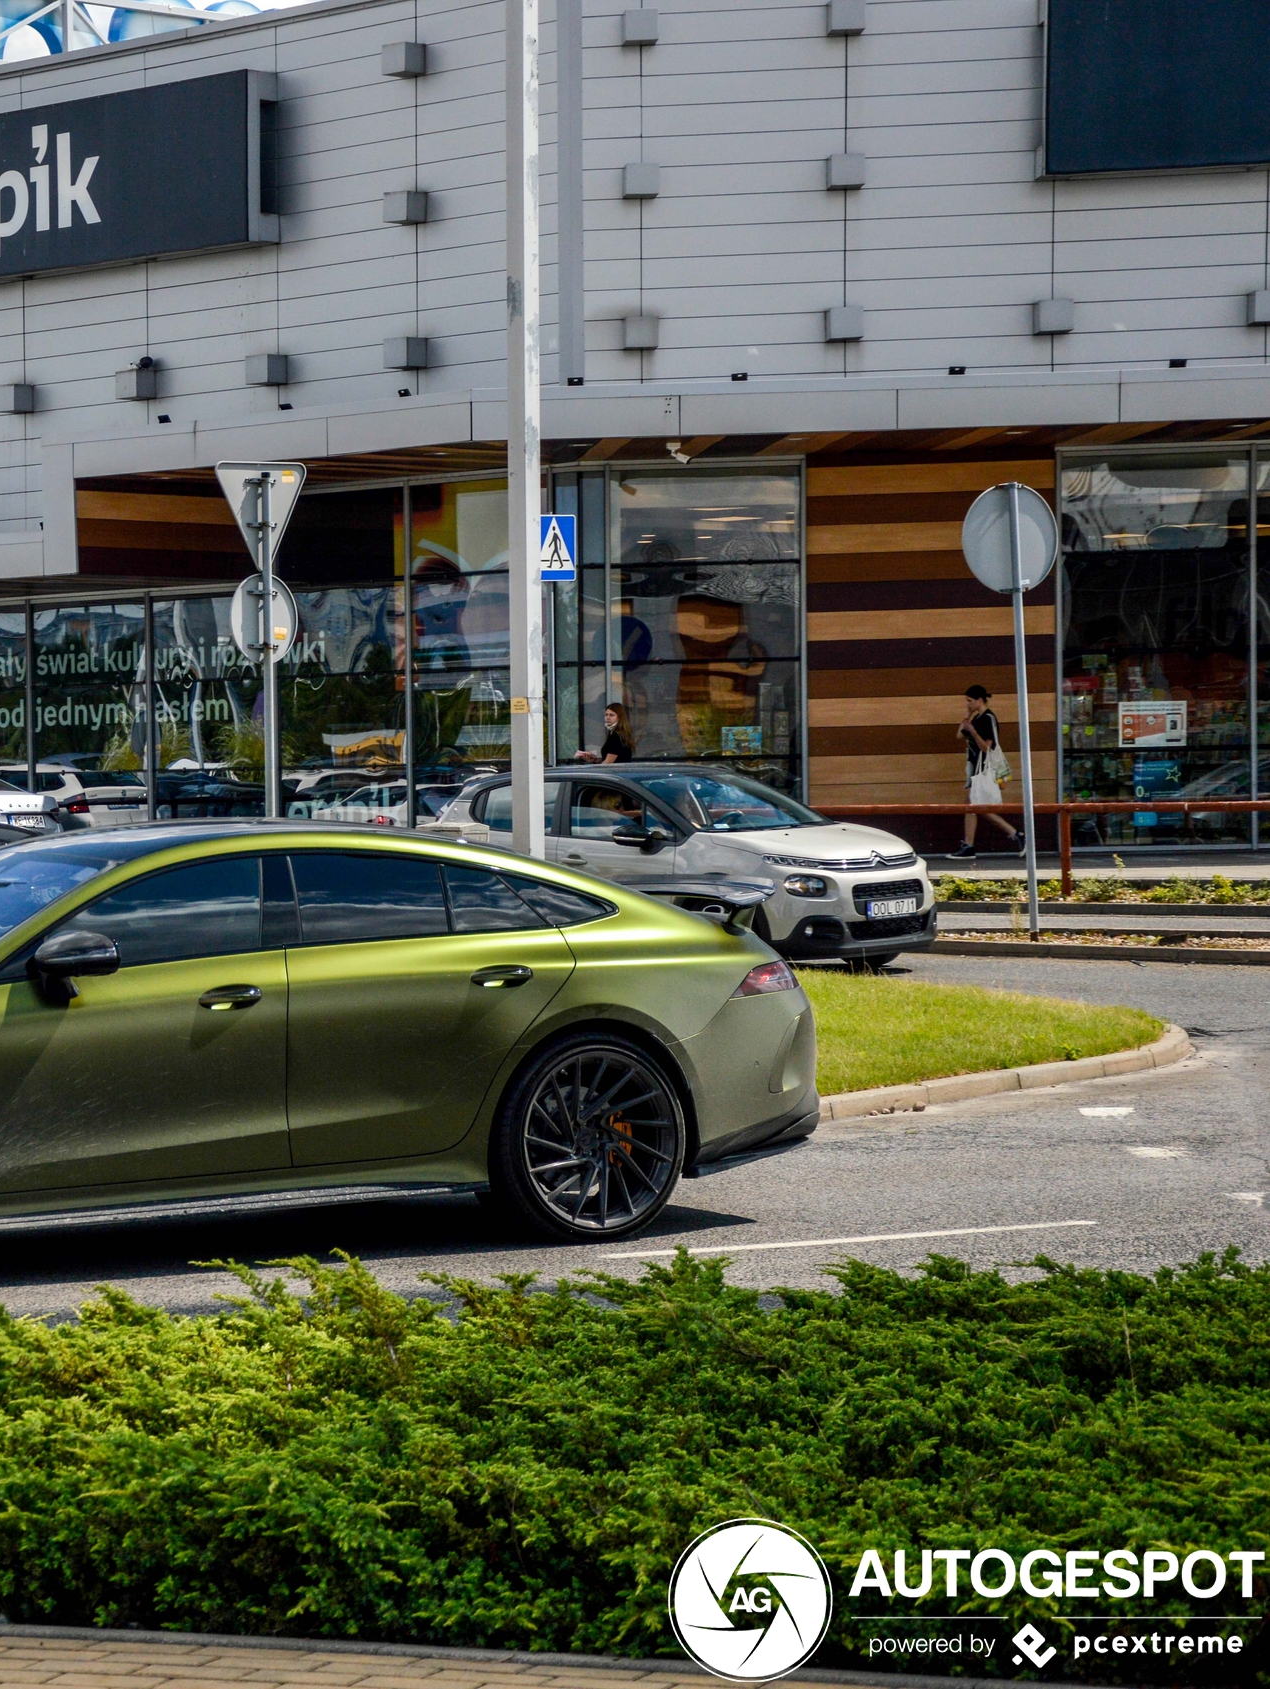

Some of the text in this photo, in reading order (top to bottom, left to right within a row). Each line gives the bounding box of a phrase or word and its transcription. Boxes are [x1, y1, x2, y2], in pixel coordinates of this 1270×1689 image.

[36, 644, 99, 676] świat
[104, 641, 192, 674] kulury
[199, 637, 206, 667] i
[211, 631, 326, 667] rozwki
[35, 697, 127, 732] jednym
[134, 692, 229, 723] hasłem
[873, 902, 893, 916] OOL
